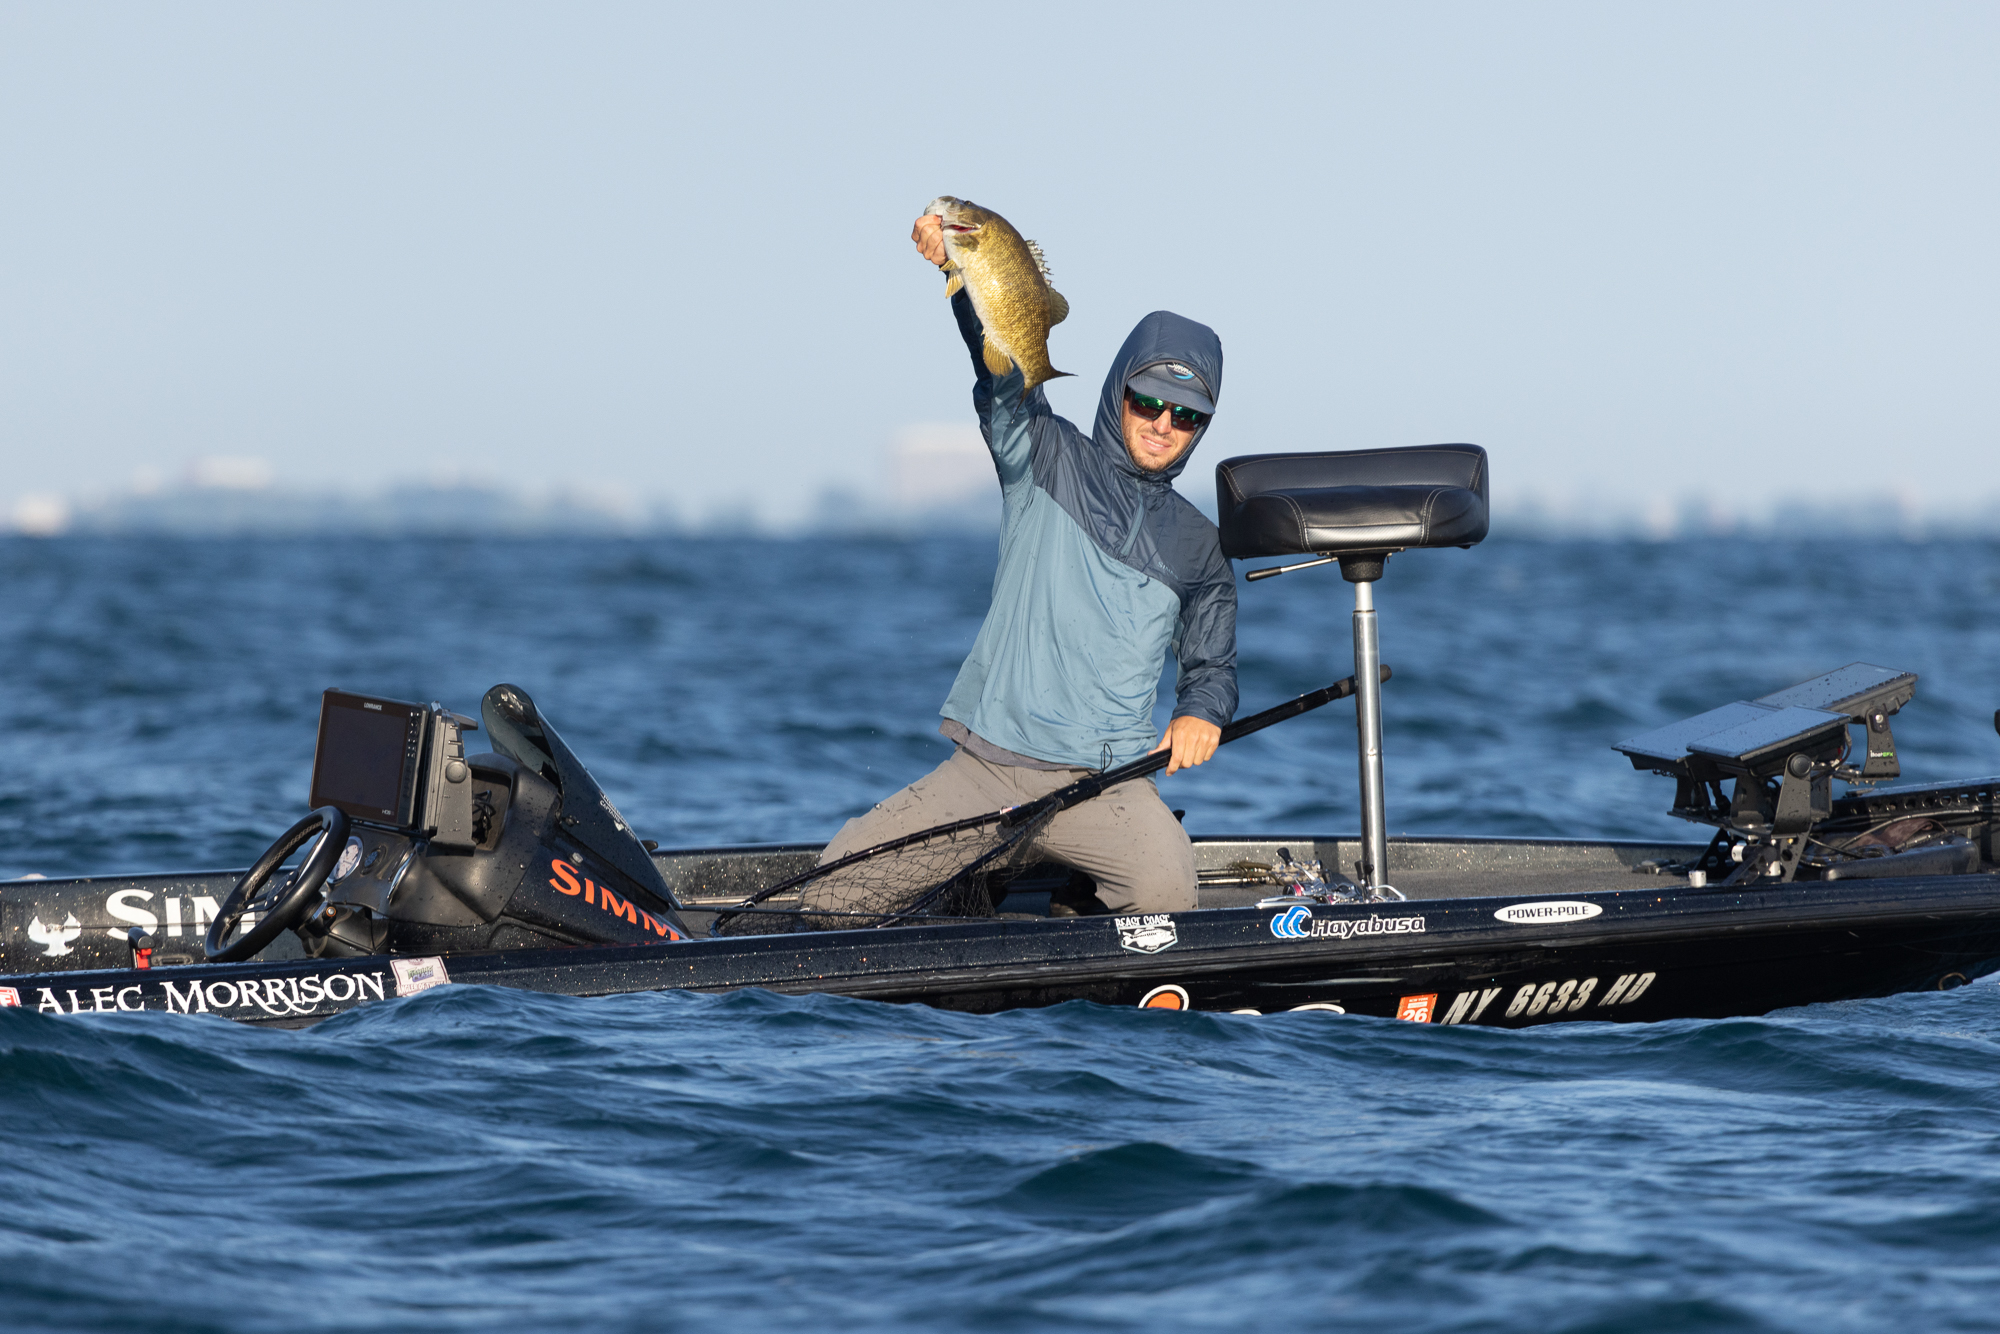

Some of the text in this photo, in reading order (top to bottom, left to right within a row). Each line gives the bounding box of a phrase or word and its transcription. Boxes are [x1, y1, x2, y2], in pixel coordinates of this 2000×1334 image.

[1114, 914, 1170, 928] BEAST COAST
[1507, 905, 1589, 919] POWER-POLE
[1310, 914, 1426, 940] Hayabusa
[36, 971, 386, 1016] ALEC MORRISON
[1439, 971, 1656, 1026] NY 6633 HD
[1402, 1008, 1429, 1023] 26
